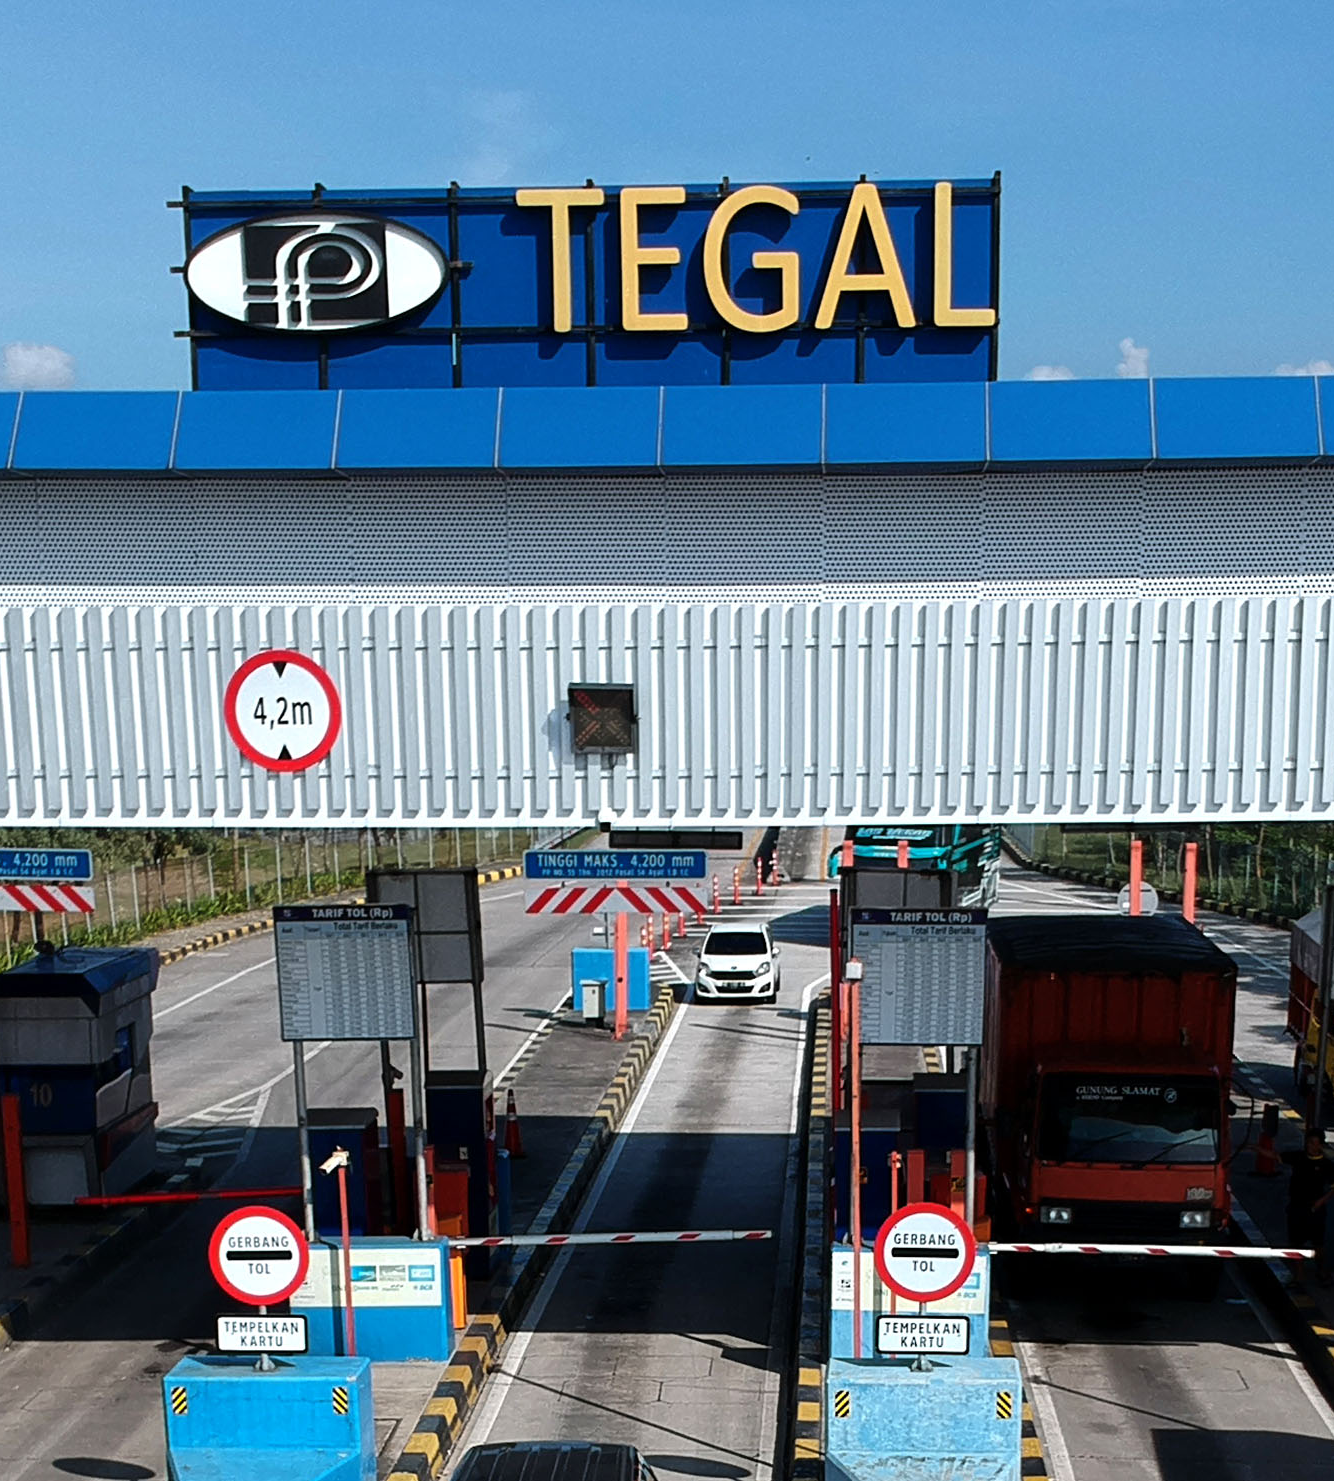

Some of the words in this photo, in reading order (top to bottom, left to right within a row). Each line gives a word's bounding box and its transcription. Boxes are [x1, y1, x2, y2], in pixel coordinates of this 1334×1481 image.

[515, 181, 996, 333] TEGAL
[253, 696, 313, 731] 4,2m
[13, 853, 49, 867] 4.200
[54, 854, 78, 867] mm
[537, 854, 578, 867] TINGGI
[584, 854, 624, 867] MAKS.
[630, 854, 666, 867] 4.200
[671, 855, 695, 867] mm
[311, 909, 344, 918] TARIF
[346, 909, 368, 918] TOL
[369, 909, 393, 919] (Rp)
[889, 912, 924, 922] TARIF
[925, 912, 946, 922] TOL
[948, 912, 972, 923] (Rp)
[333, 922, 352, 930] Total
[911, 927, 929, 935] Total
[29, 1082, 53, 1108] 10
[1076, 1086, 1118, 1095] GUNUNG
[1121, 1087, 1161, 1096] SLAMAT
[228, 1236, 289, 1248] GERBANG
[893, 1233, 956, 1245] GERBANG
[247, 1263, 271, 1275] TOL
[912, 1260, 935, 1272] TOL
[224, 1321, 299, 1334] TEMPELKAN
[885, 1322, 961, 1335] TEMPELKAN
[240, 1335, 283, 1347] KARTU
[900, 1336, 944, 1348] KARTU
